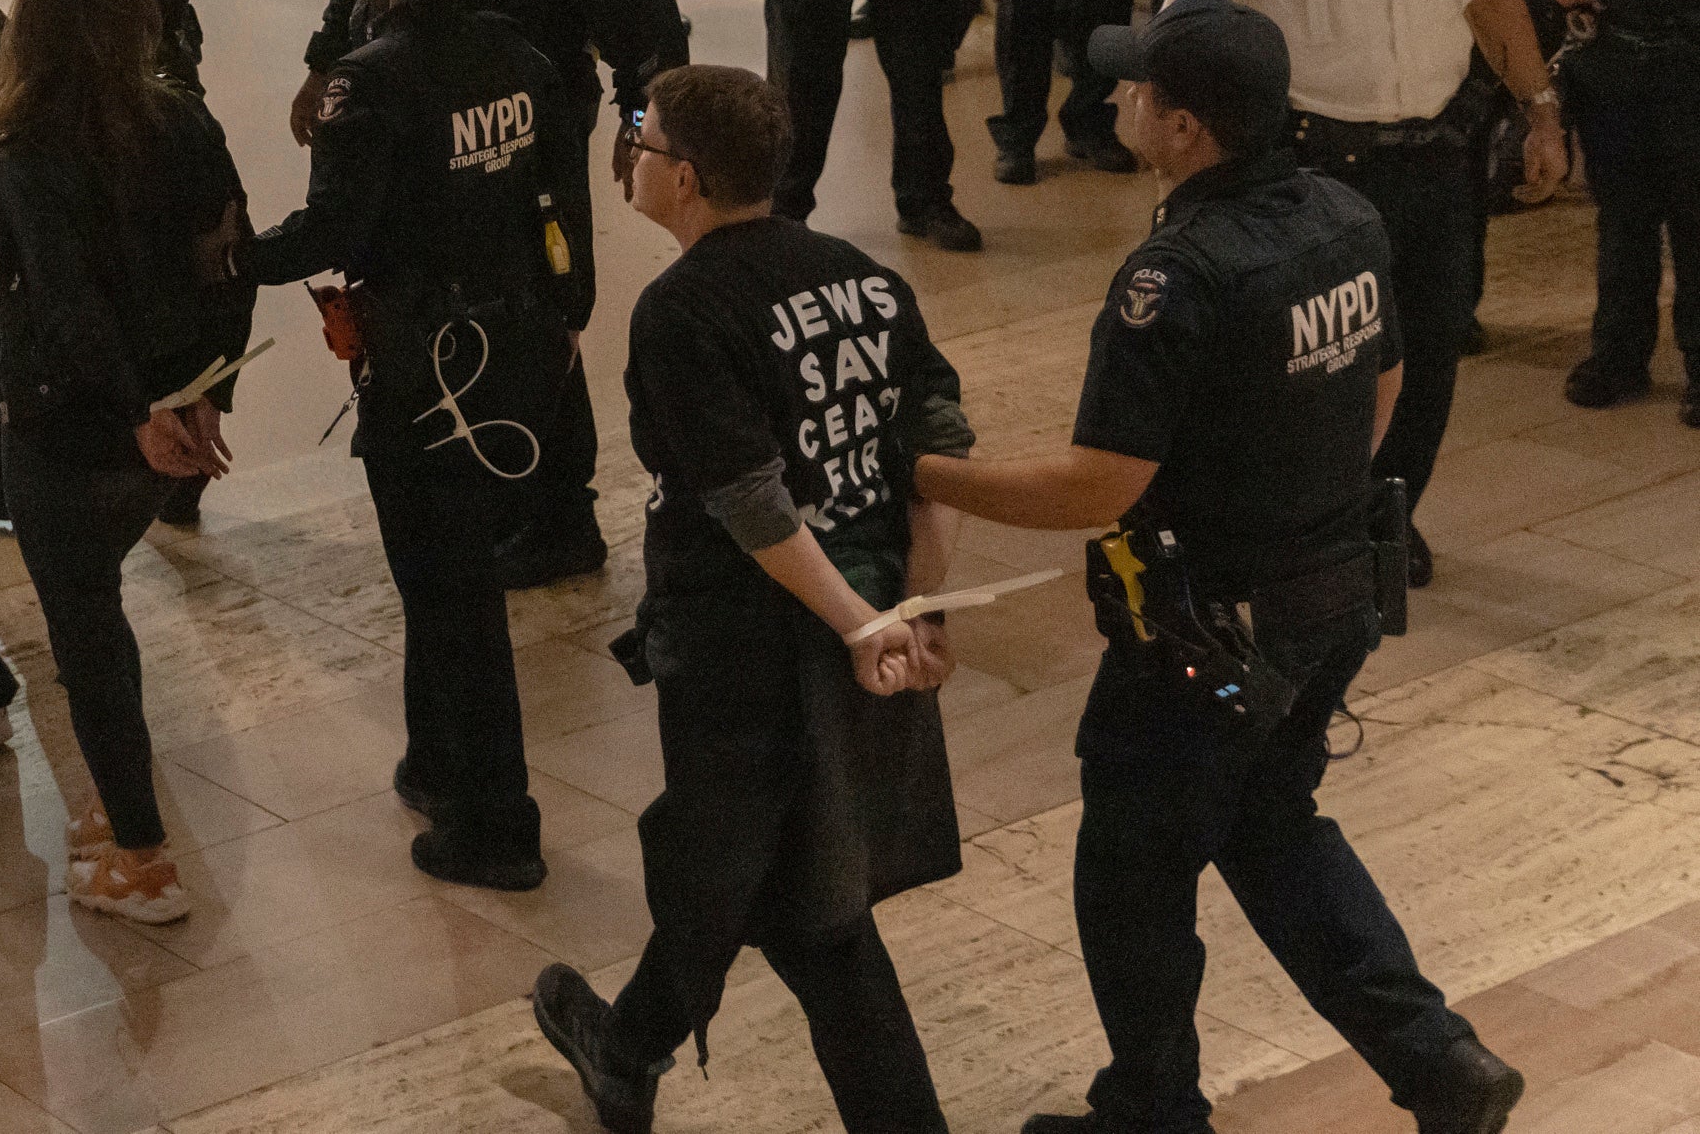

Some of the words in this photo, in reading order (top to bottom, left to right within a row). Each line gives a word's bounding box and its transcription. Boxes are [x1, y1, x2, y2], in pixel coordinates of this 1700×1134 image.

[451, 91, 534, 156] NYPD
[449, 146, 498, 170] STRATEGIC
[484, 153, 512, 173] GROUP
[1131, 268, 1168, 286] POLICE
[770, 275, 898, 352] JEWS
[1290, 270, 1379, 357] NYPD
[799, 330, 890, 403] SAY
[1286, 341, 1341, 374] STRATEGIC
[823, 436, 882, 498] FIR
